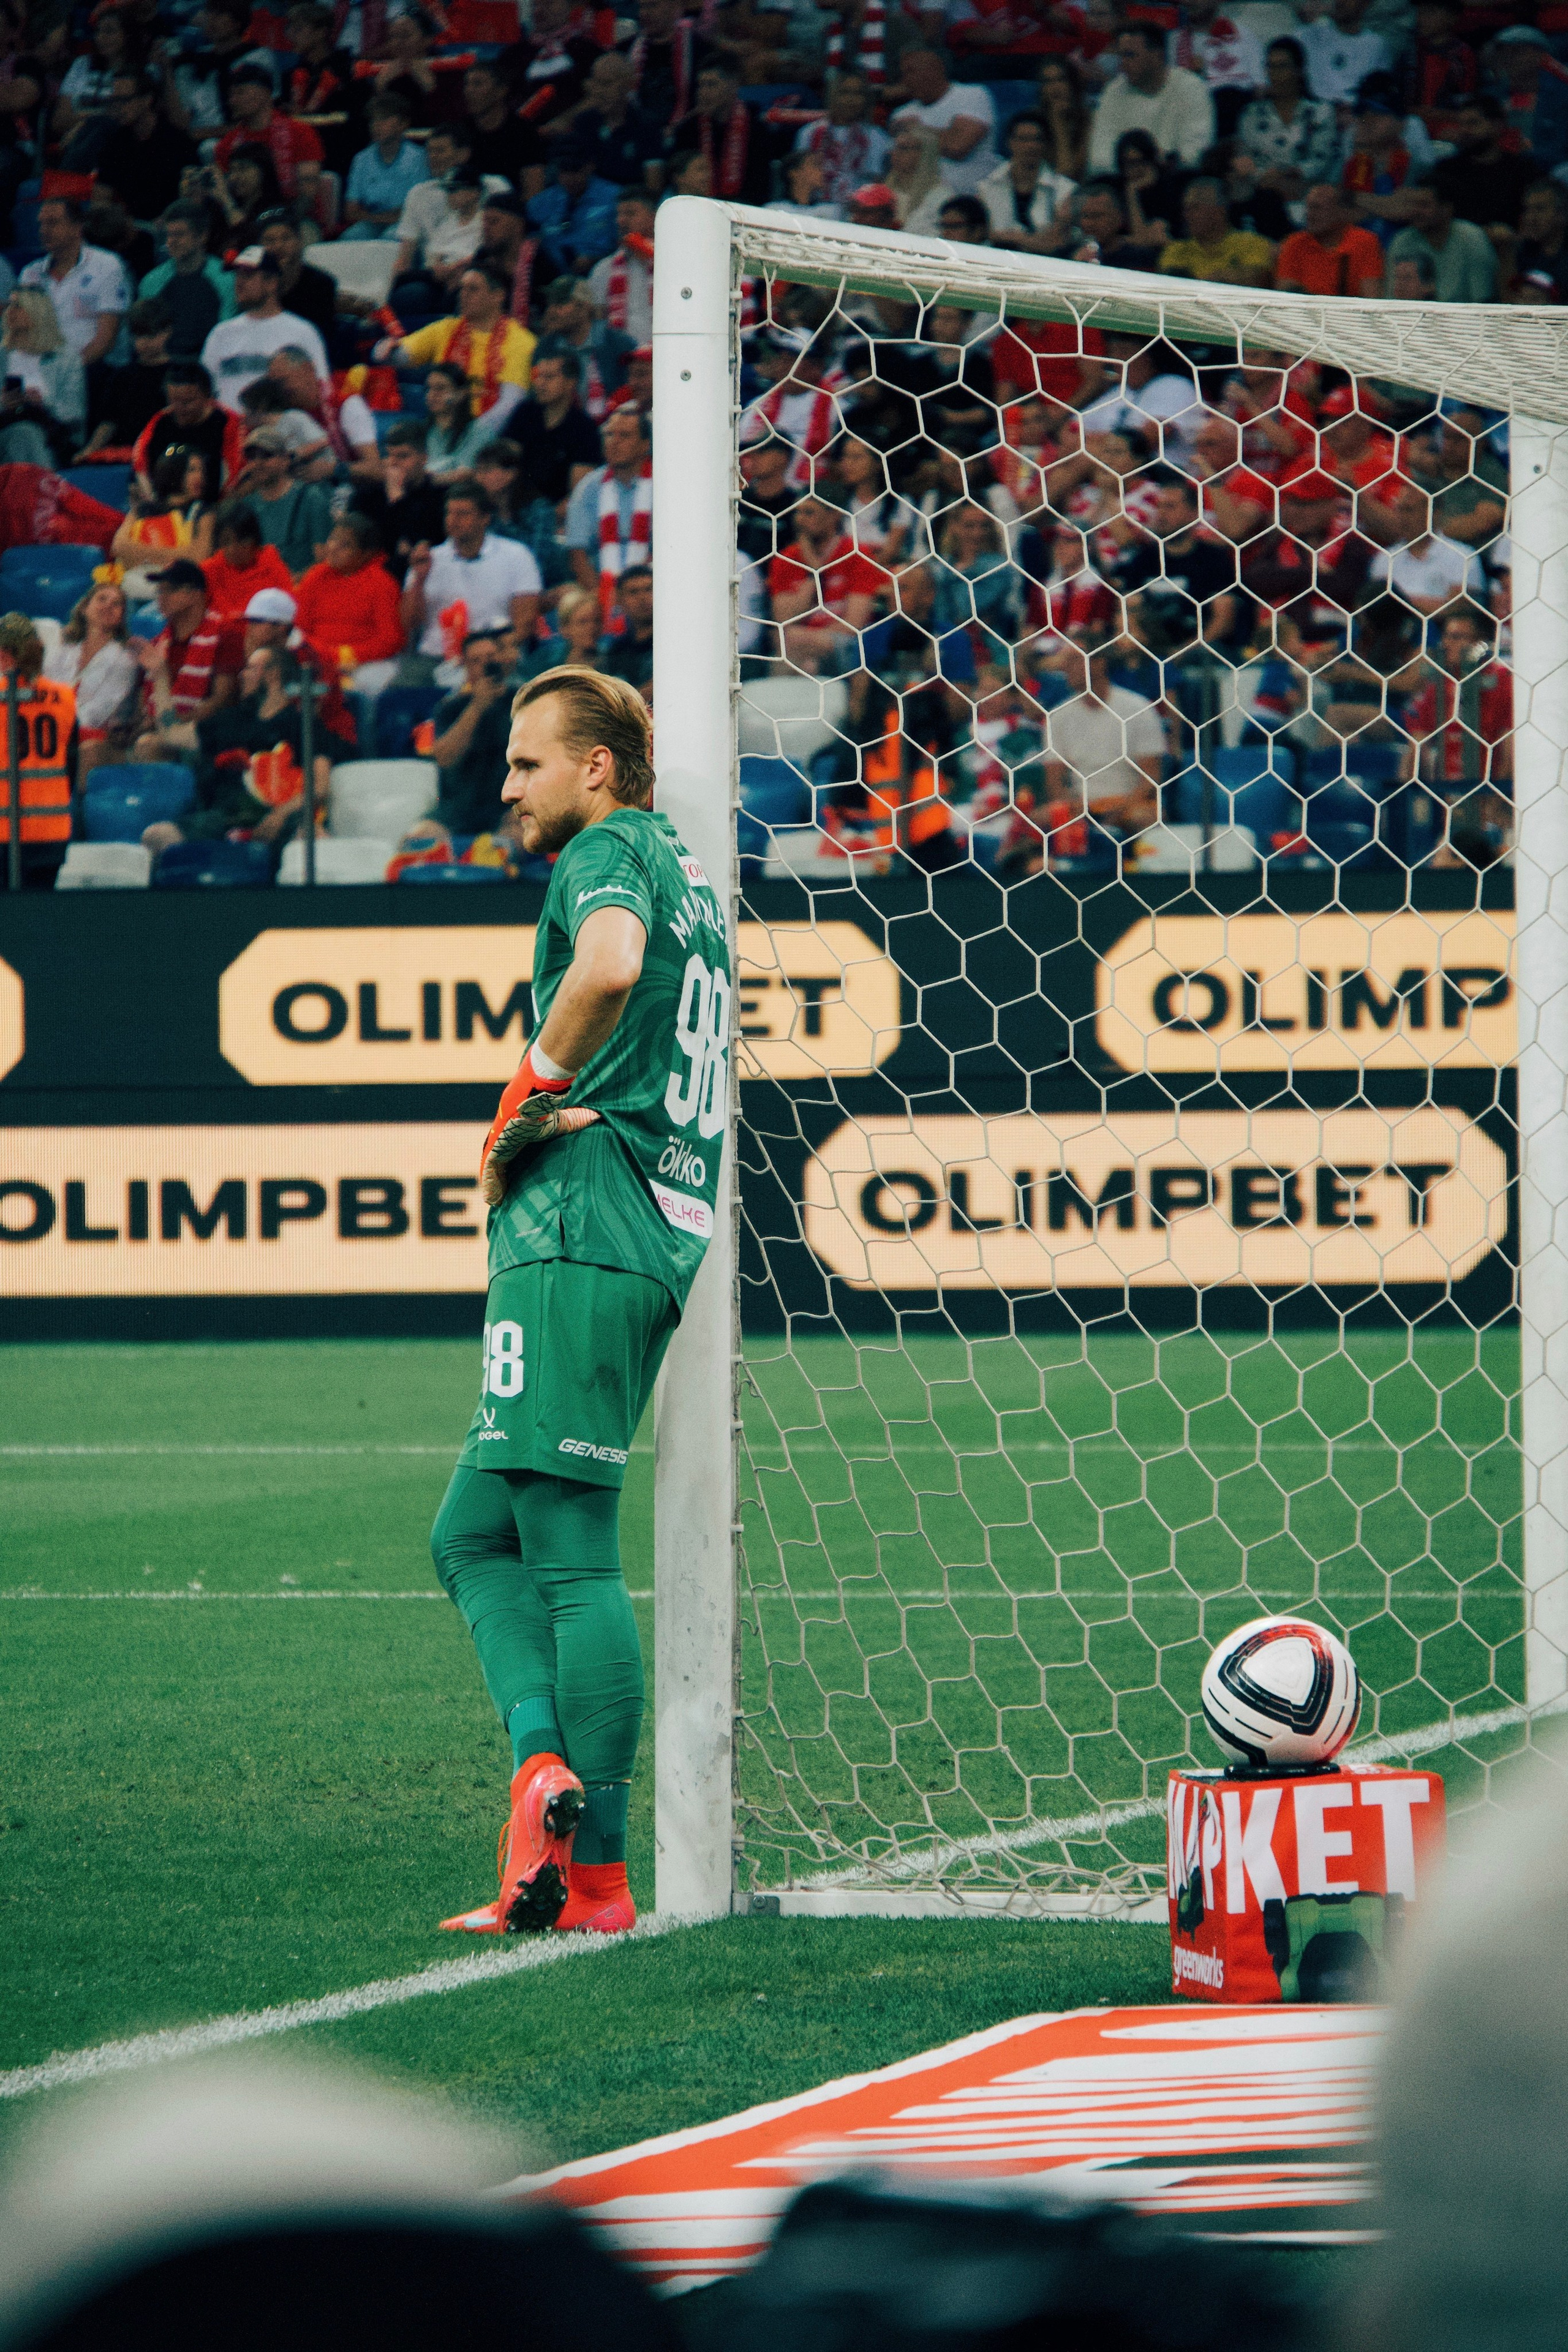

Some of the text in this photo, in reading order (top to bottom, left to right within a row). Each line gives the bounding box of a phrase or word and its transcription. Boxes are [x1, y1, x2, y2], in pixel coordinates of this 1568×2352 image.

[1153, 967, 1512, 1031] OLIMP
[665, 953, 731, 1140] 98
[0, 1177, 479, 1242] OLIMPBE
[859, 1163, 1452, 1234] OLIMPBET
[558, 1439, 629, 1464] GENESIS
